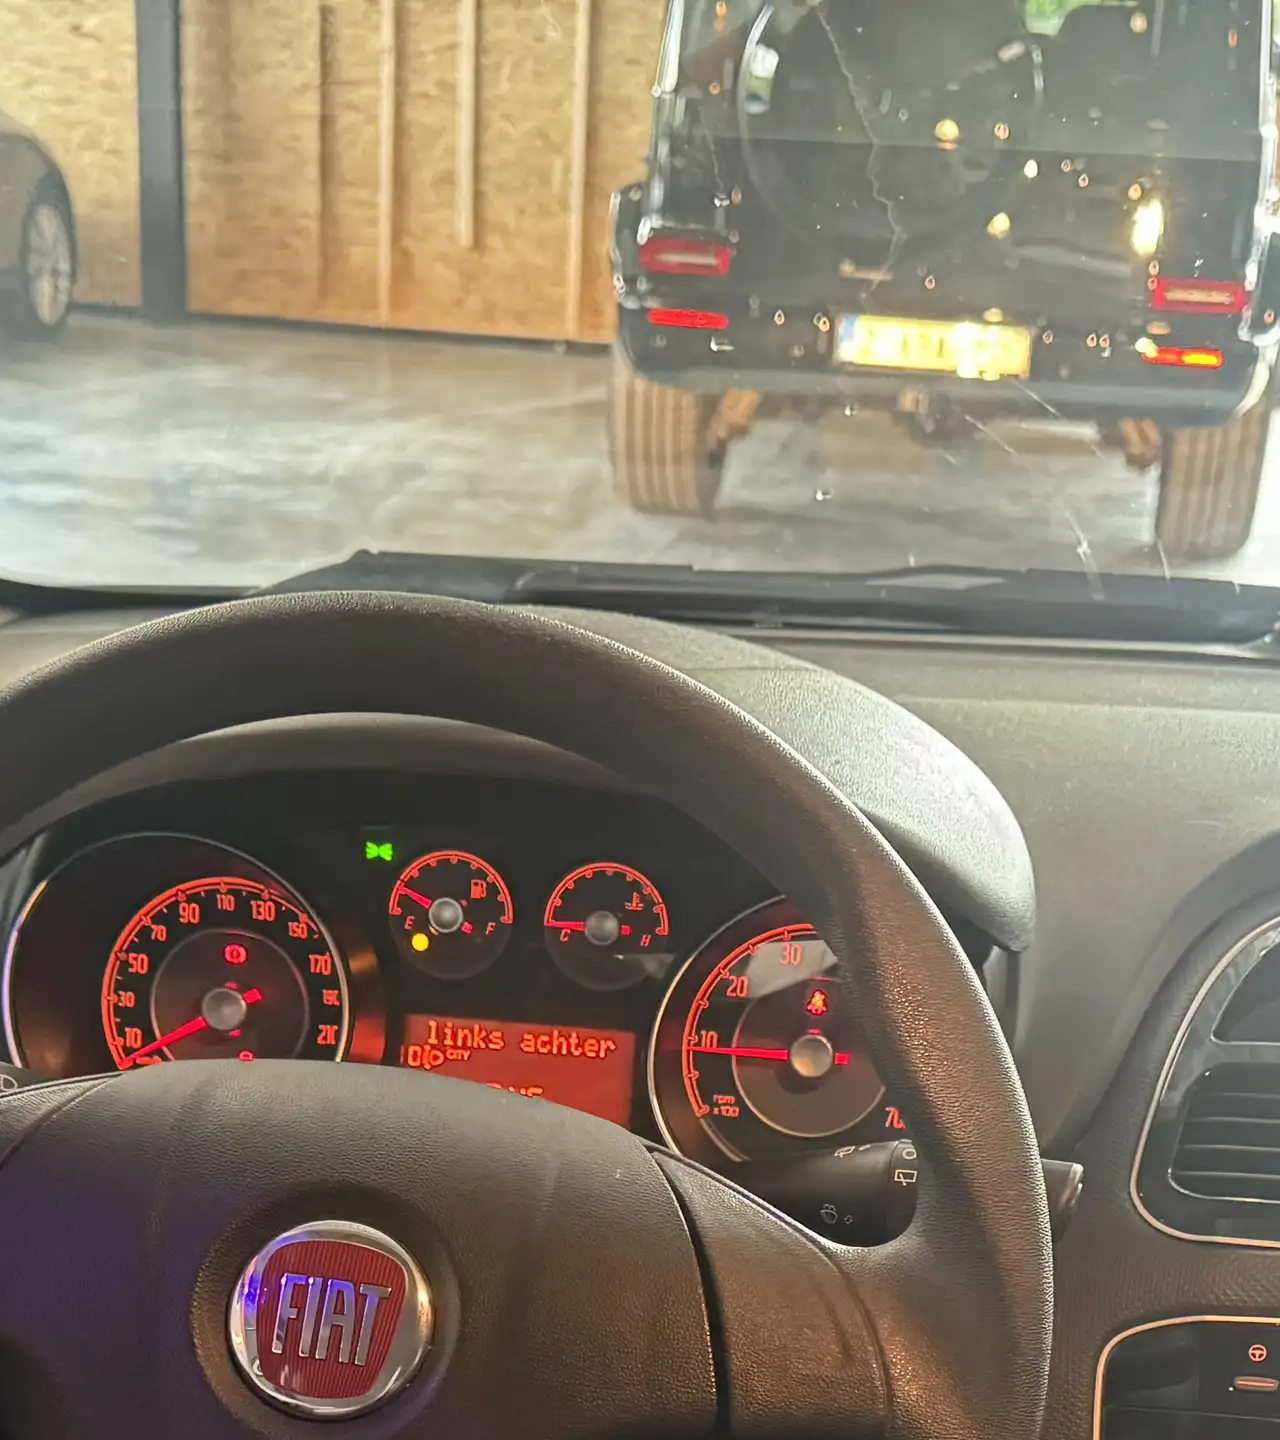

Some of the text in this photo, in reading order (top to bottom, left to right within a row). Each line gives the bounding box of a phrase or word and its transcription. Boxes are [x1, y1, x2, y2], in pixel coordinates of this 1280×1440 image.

[216, 893, 236, 912] 110
[250, 900, 276, 922] 130
[178, 903, 201, 924] 90
[403, 915, 415, 931] E
[150, 924, 168, 942] 70
[287, 921, 308, 939] 150
[485, 922, 496, 936] F
[559, 928, 571, 942] C
[639, 934, 652, 947] H
[127, 953, 149, 974] 50
[308, 952, 332, 976] 170
[780, 944, 802, 965] 30
[726, 976, 749, 998] 20
[118, 990, 136, 1008] 30
[124, 1026, 143, 1049] 10
[427, 1020, 616, 1059] links achter
[700, 1029, 718, 1049] 10
[272, 1272, 392, 1366] FIAT
